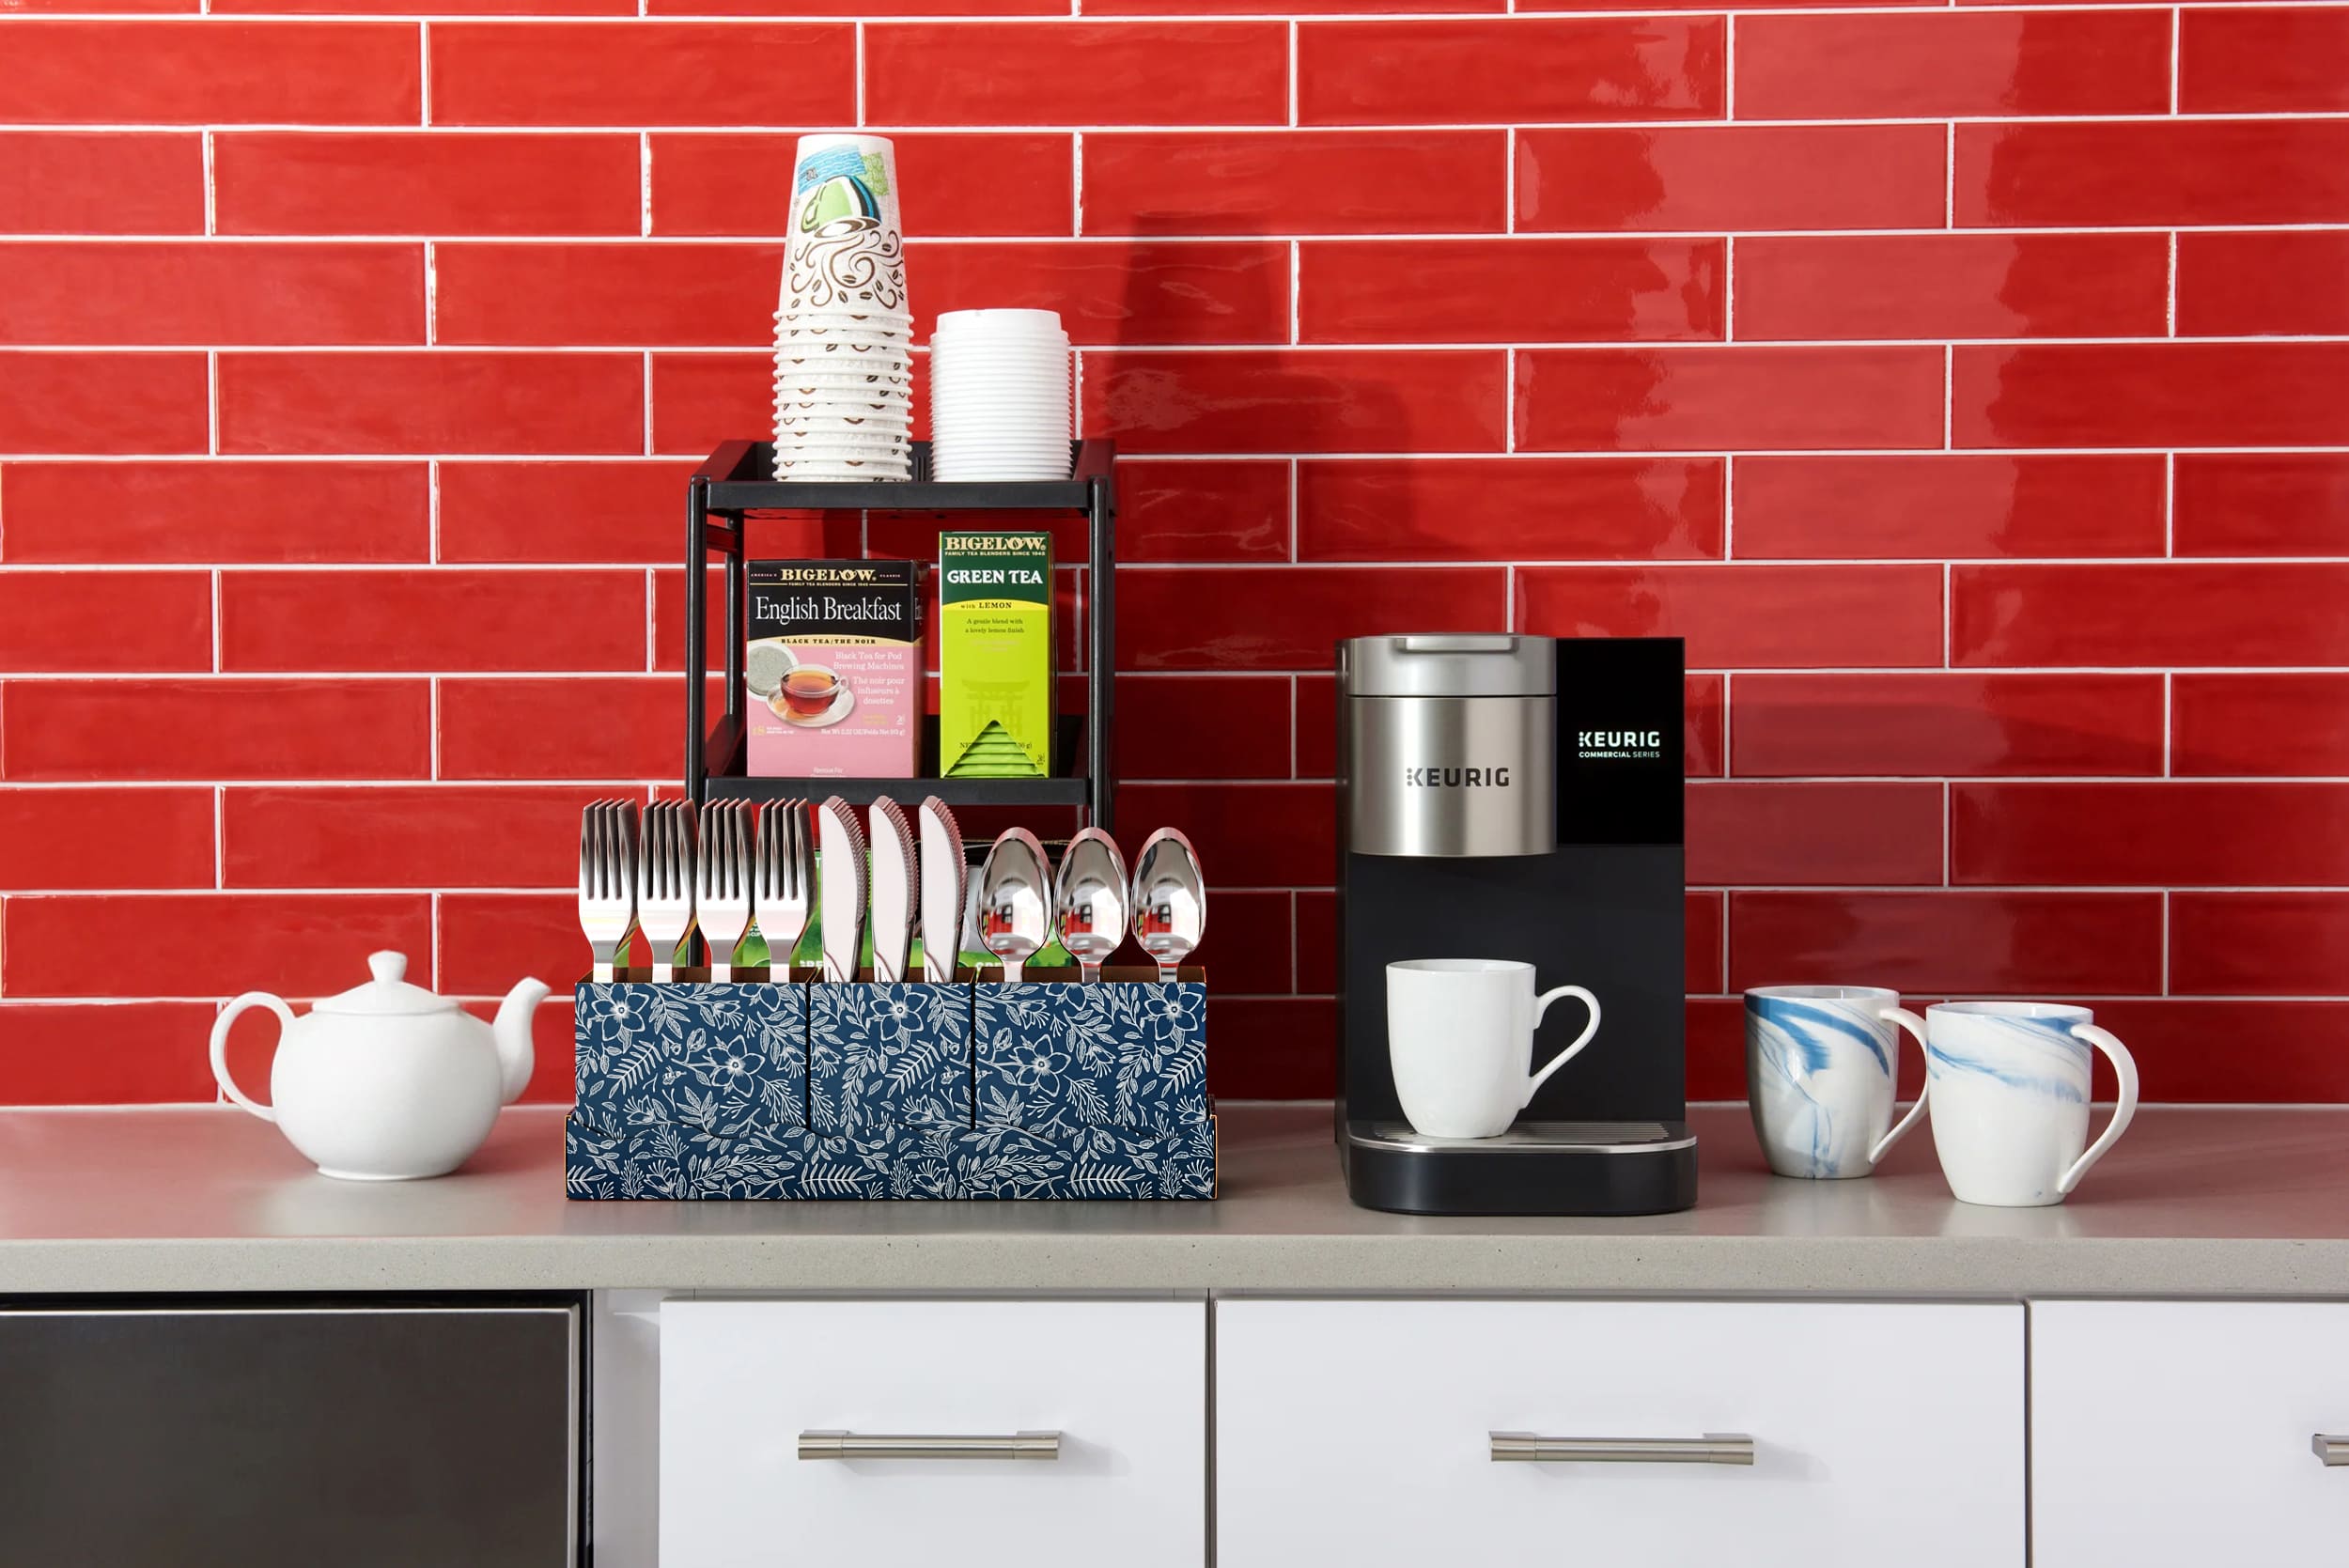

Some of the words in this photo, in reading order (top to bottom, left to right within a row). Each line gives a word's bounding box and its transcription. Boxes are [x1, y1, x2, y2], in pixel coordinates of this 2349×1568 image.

[945, 536, 1046, 551] BIGELOW
[781, 568, 876, 581] BIGELOW
[947, 570, 1004, 584] GREEN
[1008, 570, 1043, 584] TEA
[755, 597, 819, 625] English
[823, 597, 902, 621] Breakfast
[835, 651, 857, 660] Black
[858, 651, 873, 660] Tea
[875, 651, 886, 660] for
[888, 651, 902, 660] Pod
[833, 661, 866, 671] Brewing
[866, 661, 905, 670] Machines
[869, 675, 885, 685] noir
[886, 677, 905, 686] pour
[1579, 731, 1660, 747] KEURIG
[1407, 768, 1509, 787] KEURIG
